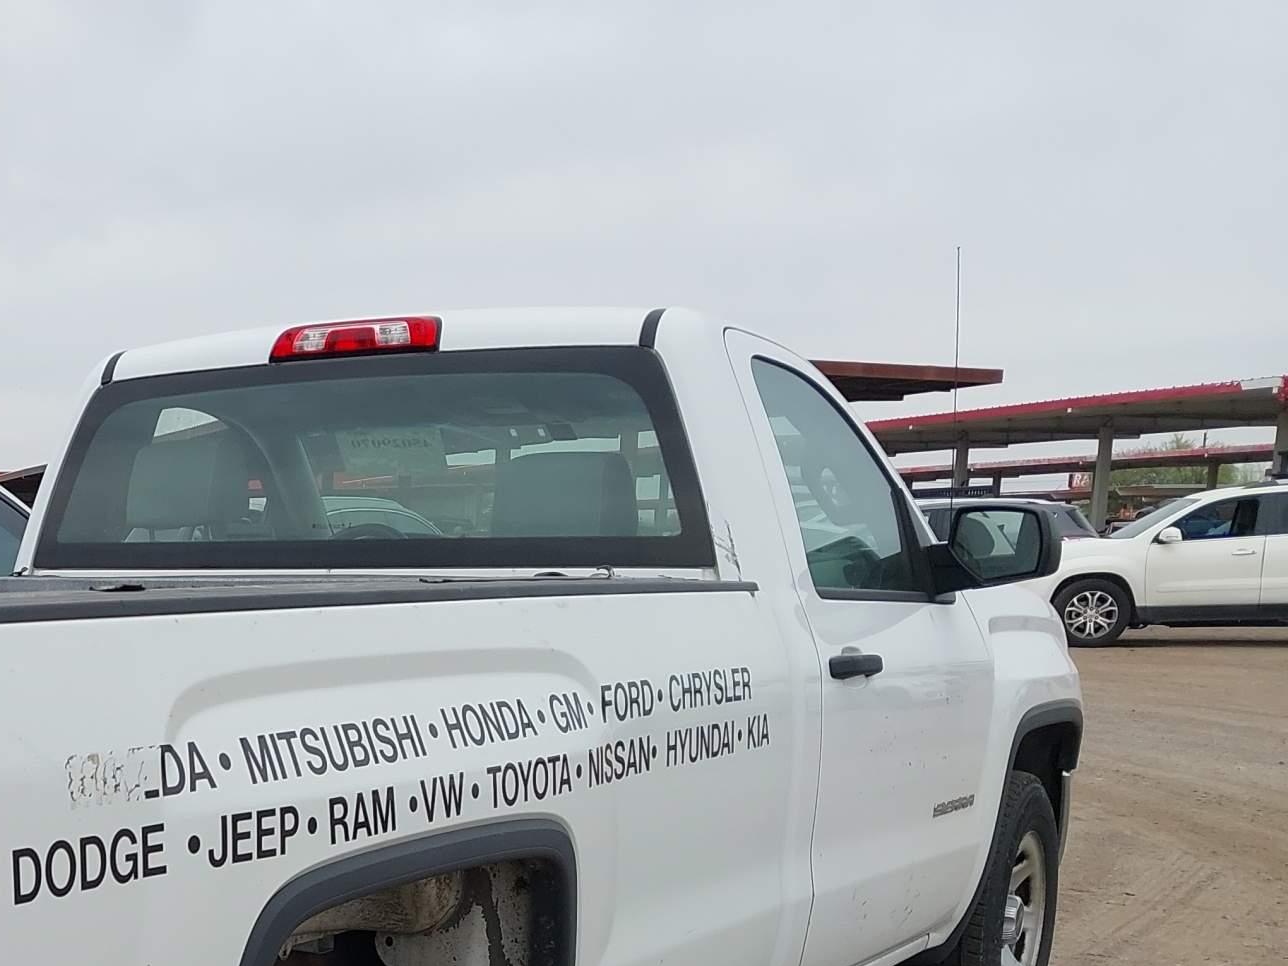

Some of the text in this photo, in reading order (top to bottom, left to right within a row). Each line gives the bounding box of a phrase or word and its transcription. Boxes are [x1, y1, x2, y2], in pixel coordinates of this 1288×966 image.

[239, 714, 428, 785] MITSUBISHI
[440, 698, 538, 749] HONDA
[549, 692, 588, 734] GM
[600, 679, 654, 722] FORD
[668, 667, 752, 712] CHRYSLER
[12, 713, 770, 905] DODGE JEEP RAM VW TOYOTA NISSAN HYUNDAI KIA
